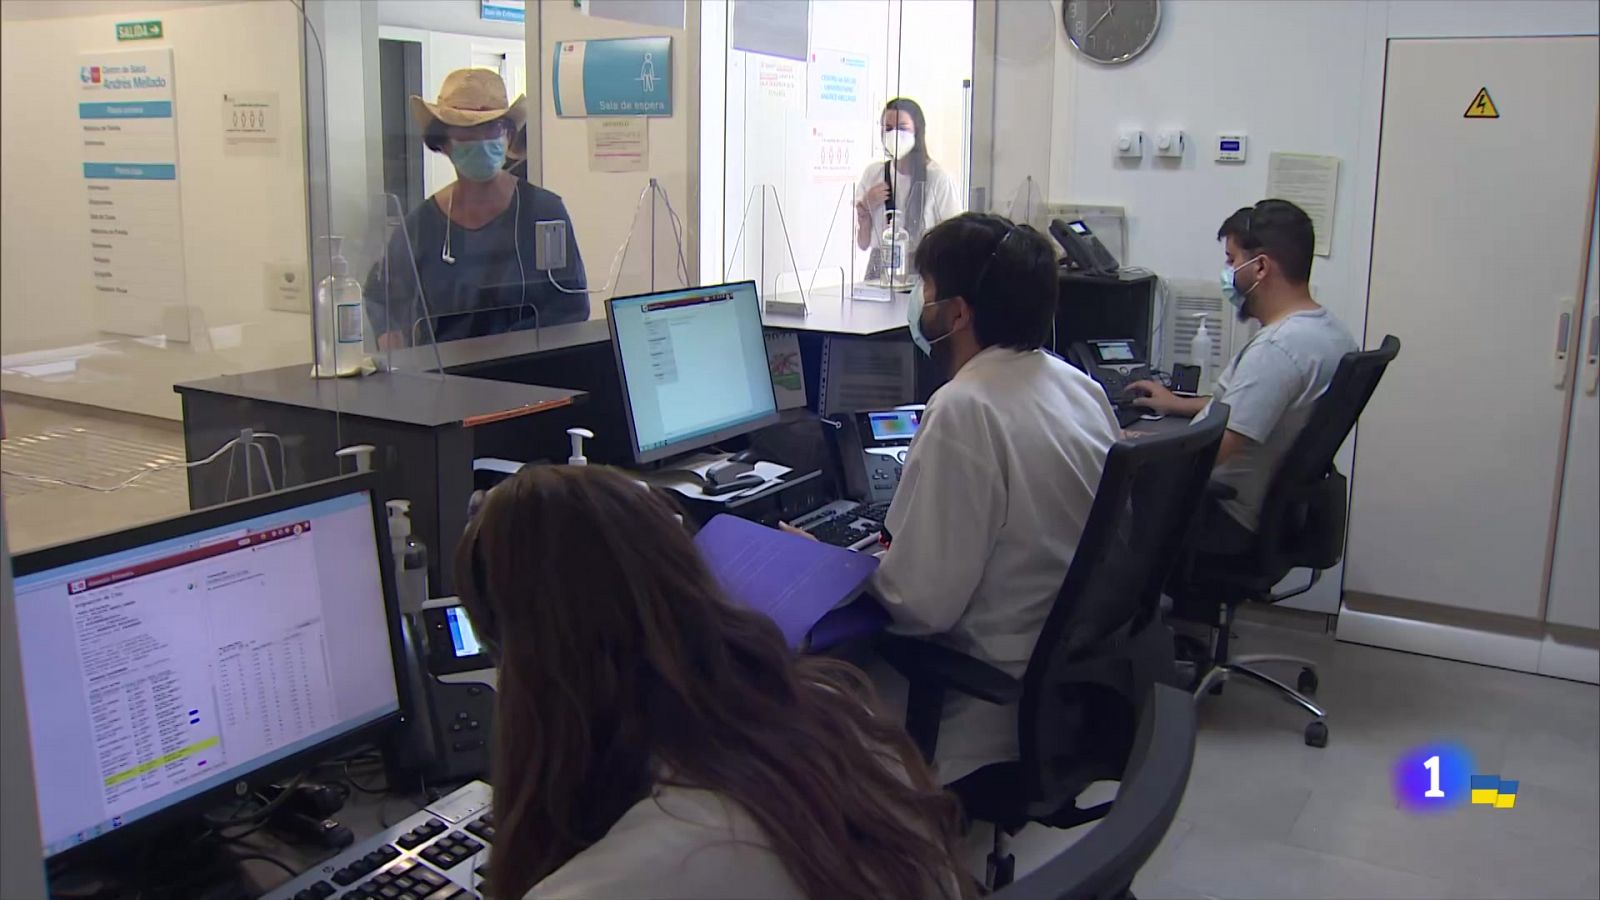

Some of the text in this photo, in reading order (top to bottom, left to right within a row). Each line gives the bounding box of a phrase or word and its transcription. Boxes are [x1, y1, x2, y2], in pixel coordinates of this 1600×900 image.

[119, 24, 148, 38] SALIDA
[132, 76, 166, 88] Mellado
[600, 100, 665, 111] Sala de espera
